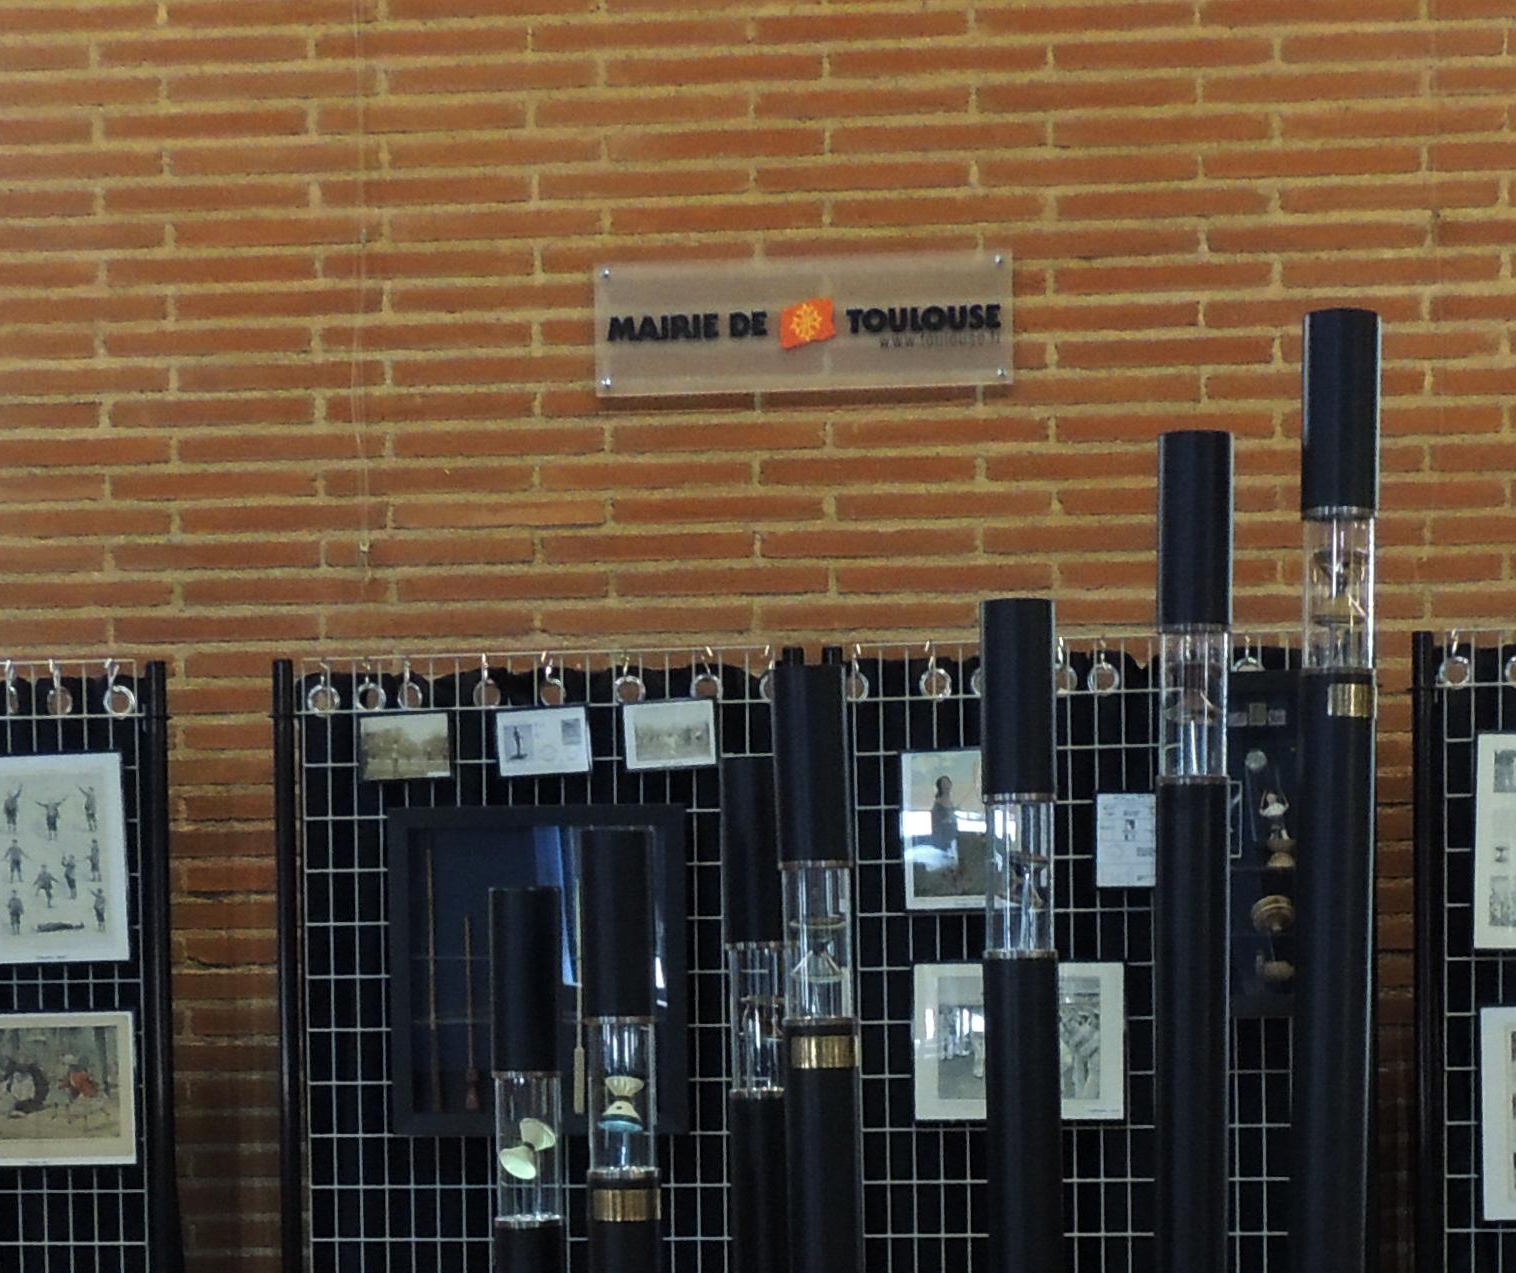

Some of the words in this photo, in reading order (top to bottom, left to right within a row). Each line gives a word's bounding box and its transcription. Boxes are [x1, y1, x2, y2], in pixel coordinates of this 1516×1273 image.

[606, 312, 720, 342] MAIRIE
[728, 310, 769, 338] DE
[845, 302, 1003, 335] TOULOUSE
